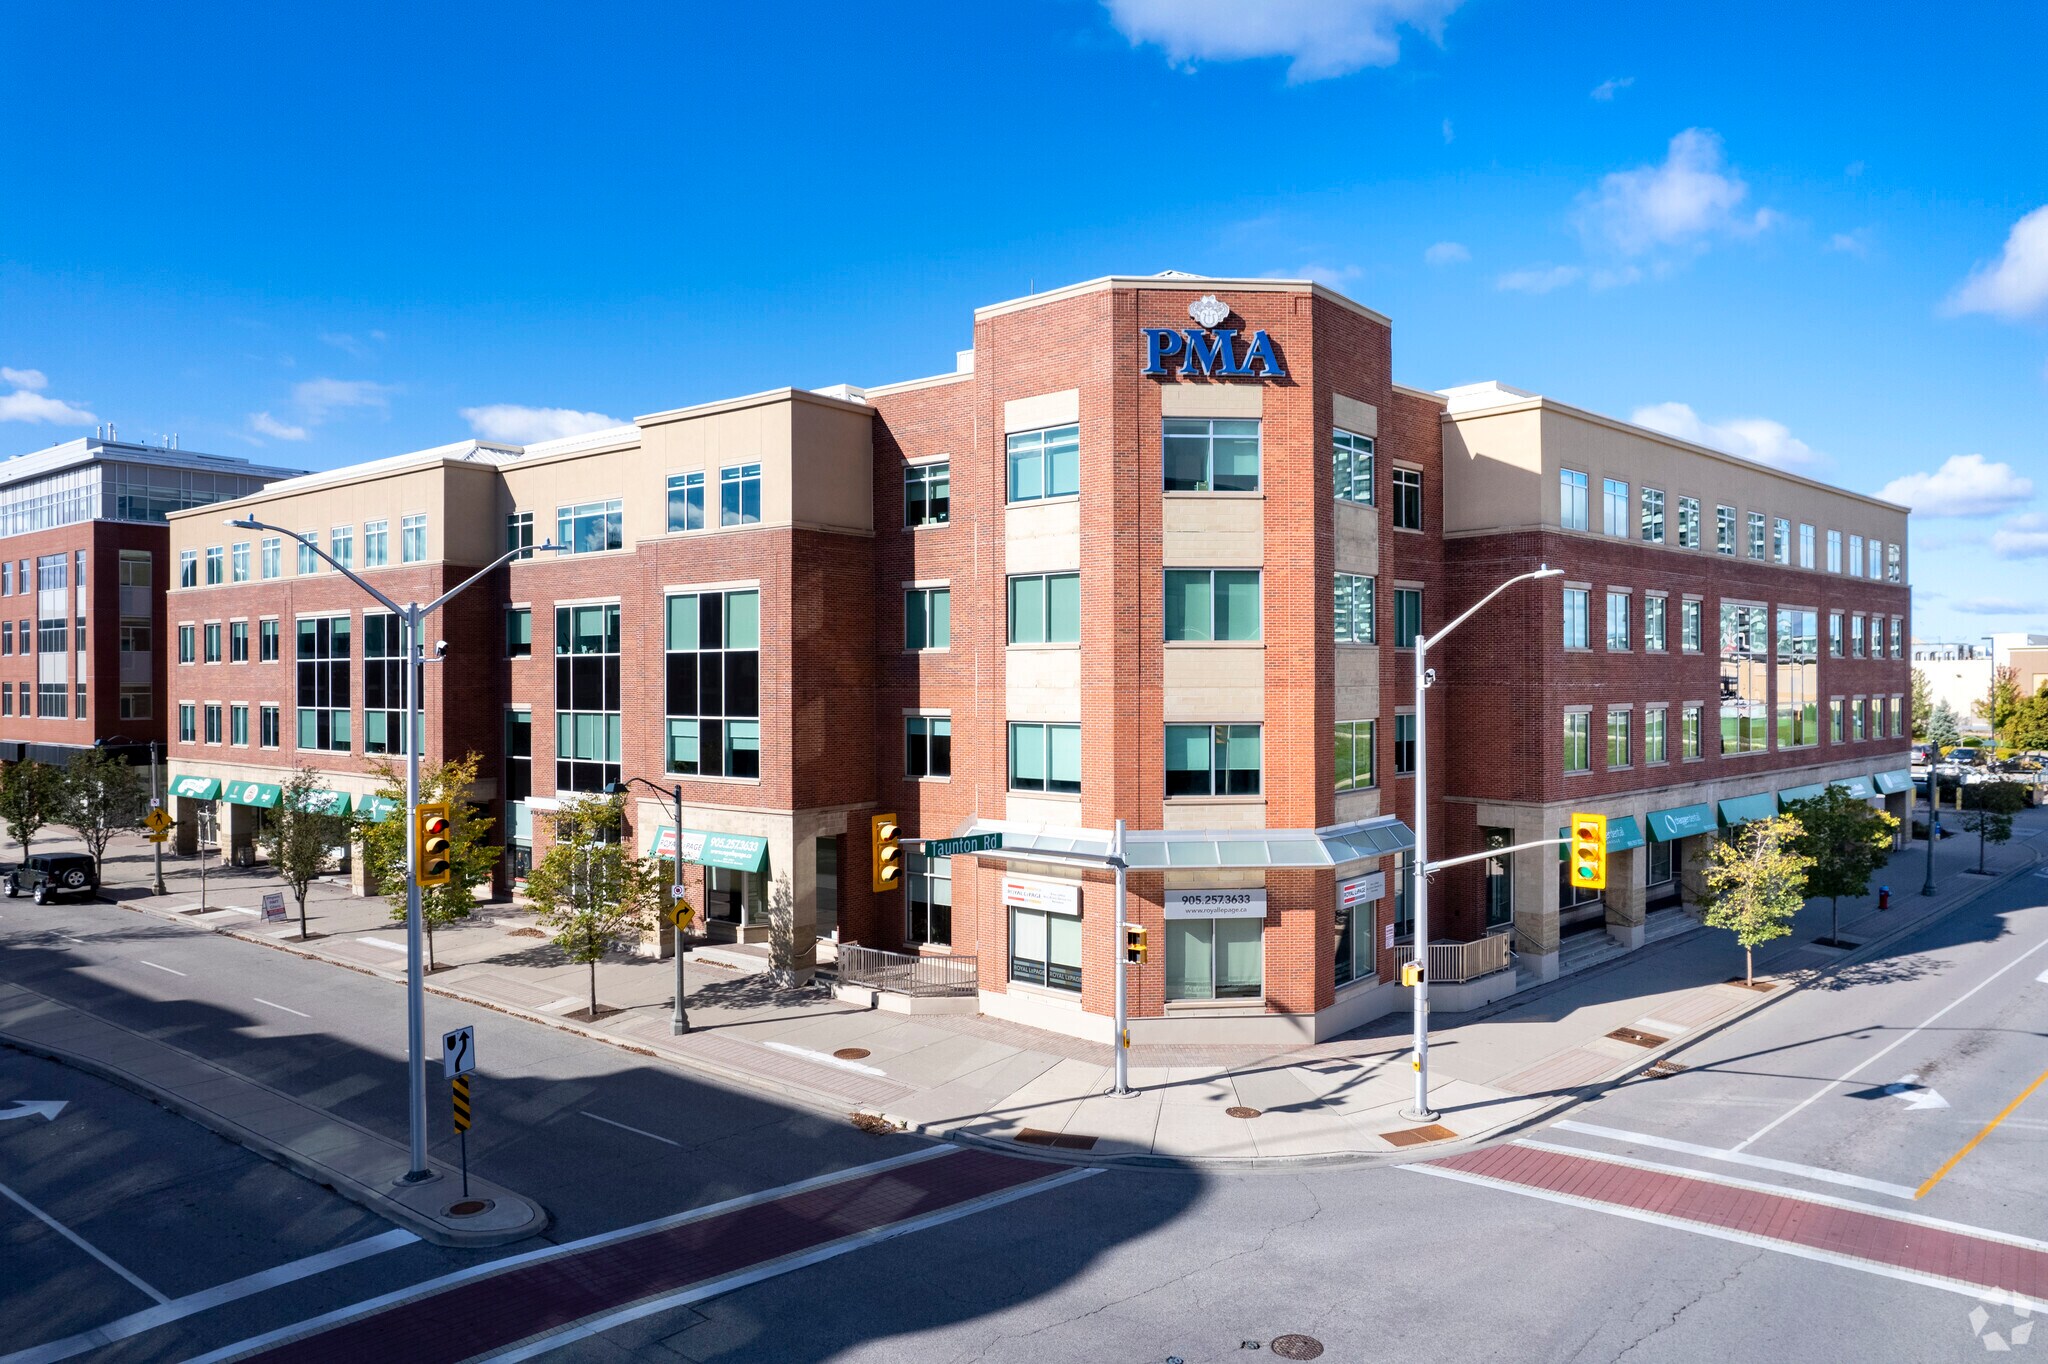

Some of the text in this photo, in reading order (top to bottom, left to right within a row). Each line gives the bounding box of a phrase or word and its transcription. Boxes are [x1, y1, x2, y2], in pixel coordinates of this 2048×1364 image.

[1141, 328, 1286, 377] PMA
[660, 839, 677, 849] ROYA
[931, 833, 997, 857] Taunton Rd
[1182, 894, 1251, 905] 905.257.3633
[1185, 906, 1248, 914] www.royallepage.ca
[1013, 965, 1029, 973] ROYAL
[1049, 971, 1065, 979] ROYAL
